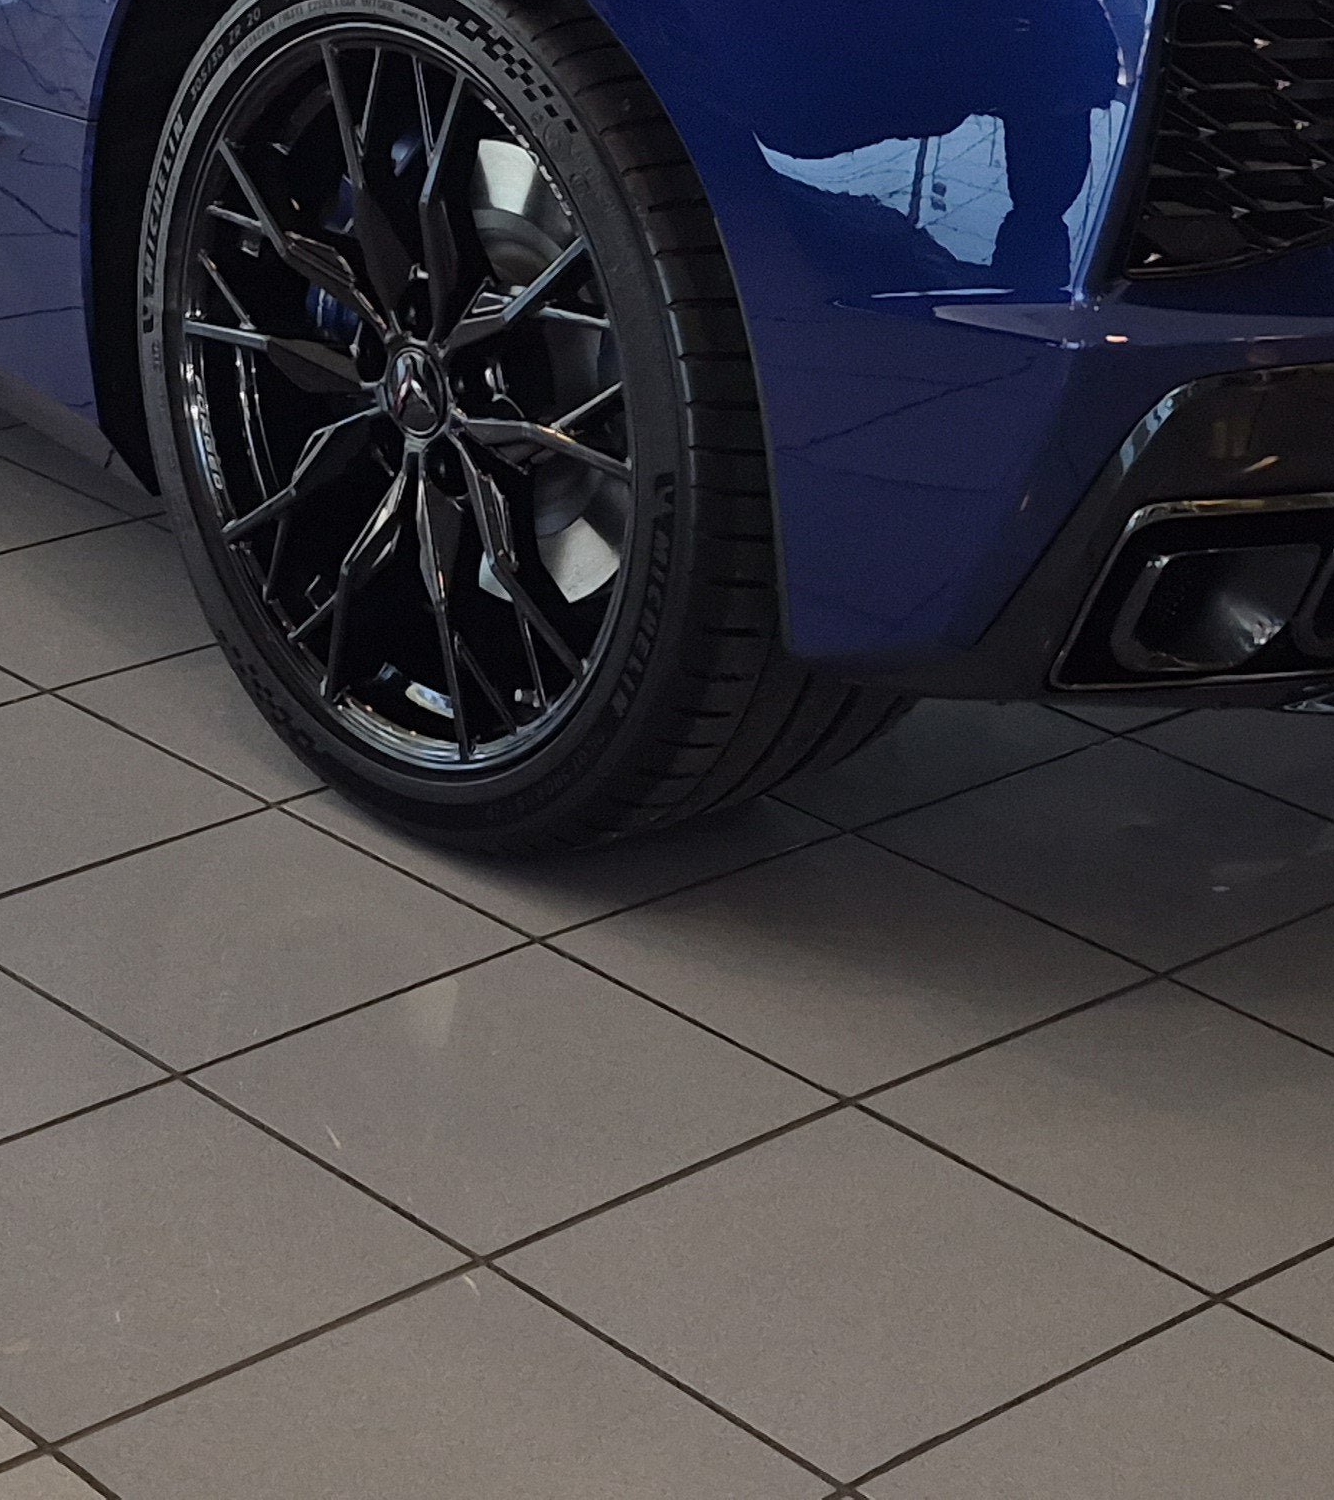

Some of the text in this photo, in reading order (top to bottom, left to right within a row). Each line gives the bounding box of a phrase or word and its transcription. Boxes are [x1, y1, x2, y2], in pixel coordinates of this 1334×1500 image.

[190, 44, 224, 101] 305/30
[247, 7, 261, 27] 20
[144, 112, 185, 286] MICHELIN
[610, 528, 671, 719] MICHELIN
